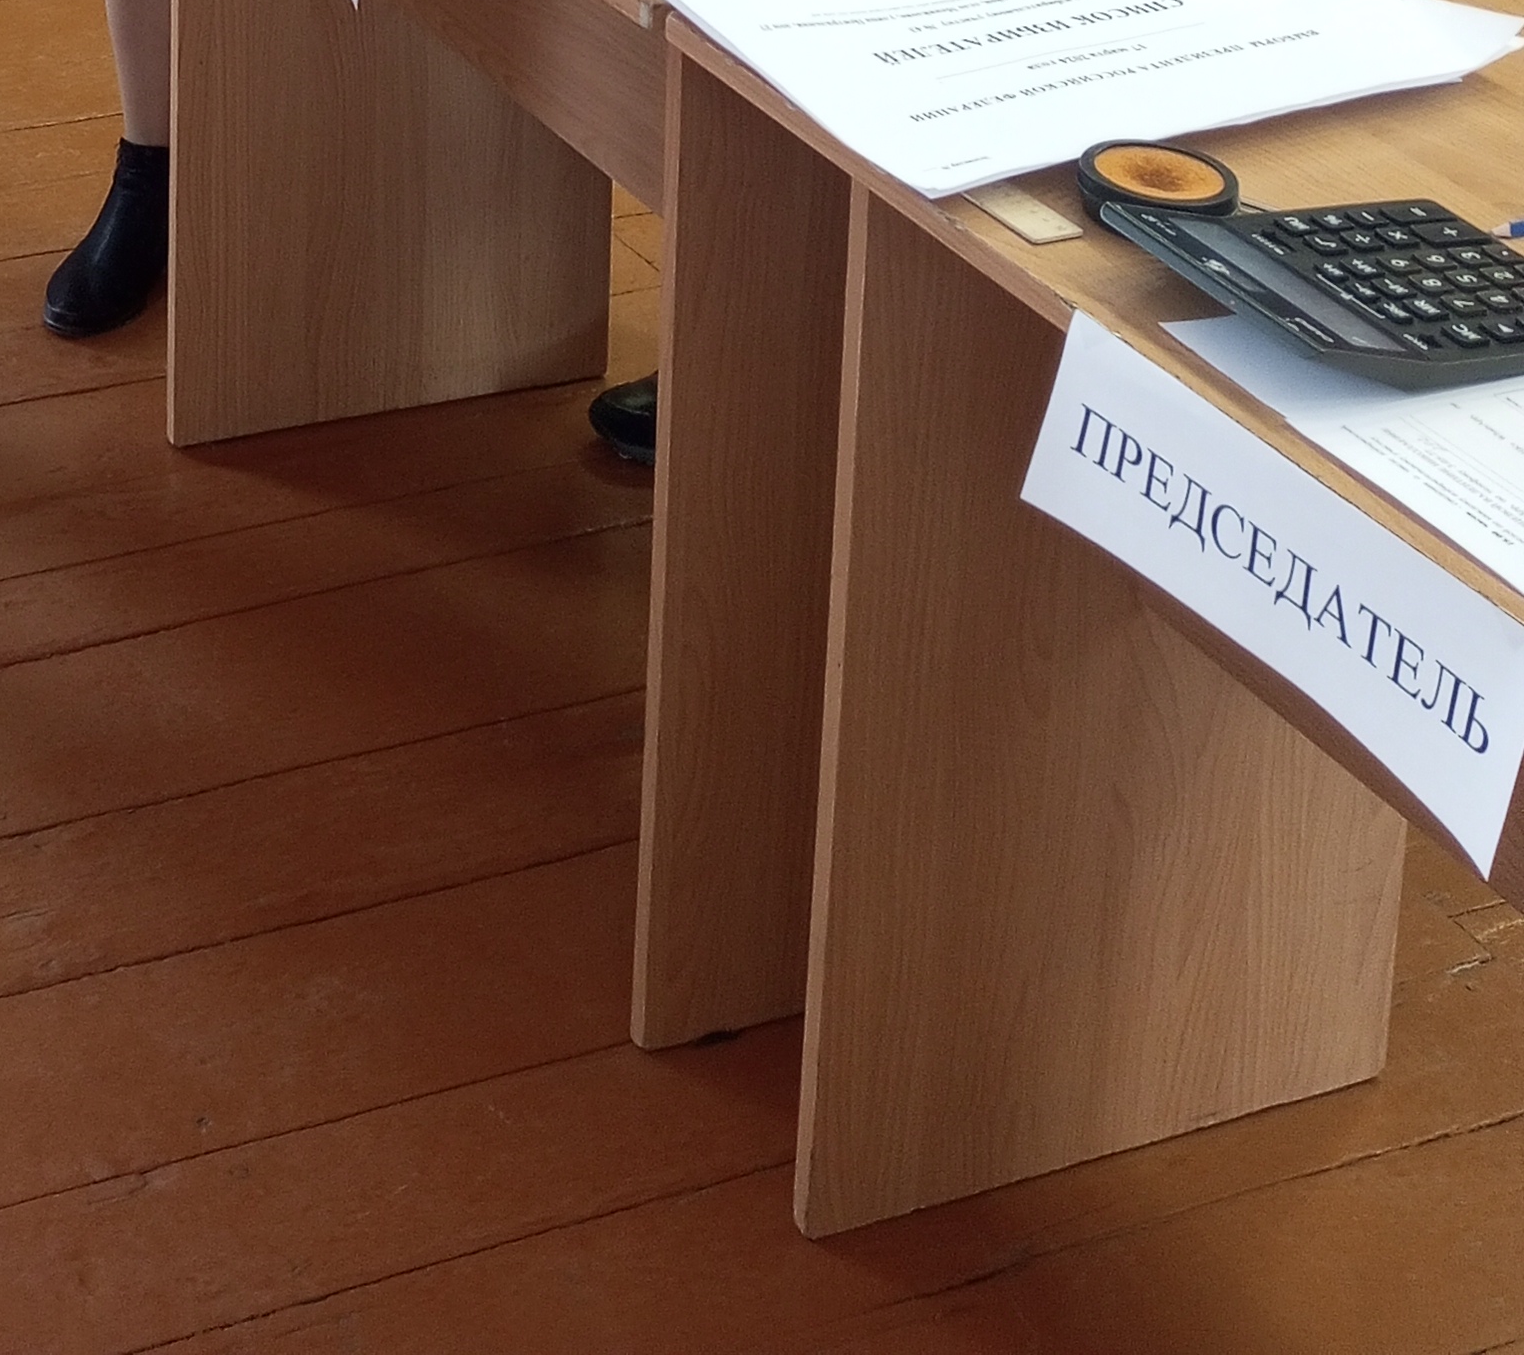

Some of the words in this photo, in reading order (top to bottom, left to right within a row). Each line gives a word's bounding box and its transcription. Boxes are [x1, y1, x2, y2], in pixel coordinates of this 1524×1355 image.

[872, 19, 1071, 66] ИЗБИРАТЕЛЕЙ
[1248, 29, 1320, 48] ВЫБОРЫ
[1136, 44, 1244, 71] ПРЕЗИДЕНТА
[1019, 67, 1135, 98] РОССИЙСКОЙ
[909, 93, 1017, 123] ФЕДЕРАЦИИ
[1426, 254, 1446, 264] 6
[1460, 251, 1482, 260] 3
[1390, 258, 1409, 268] 9
[1456, 274, 1478, 284] 5
[1493, 271, 1515, 281] 2
[1421, 278, 1443, 288] 8
[1452, 299, 1475, 309] 7
[1489, 294, 1510, 305] 4
[1070, 403, 1492, 758] ПРЕДСЕДАТЕЛЬ
